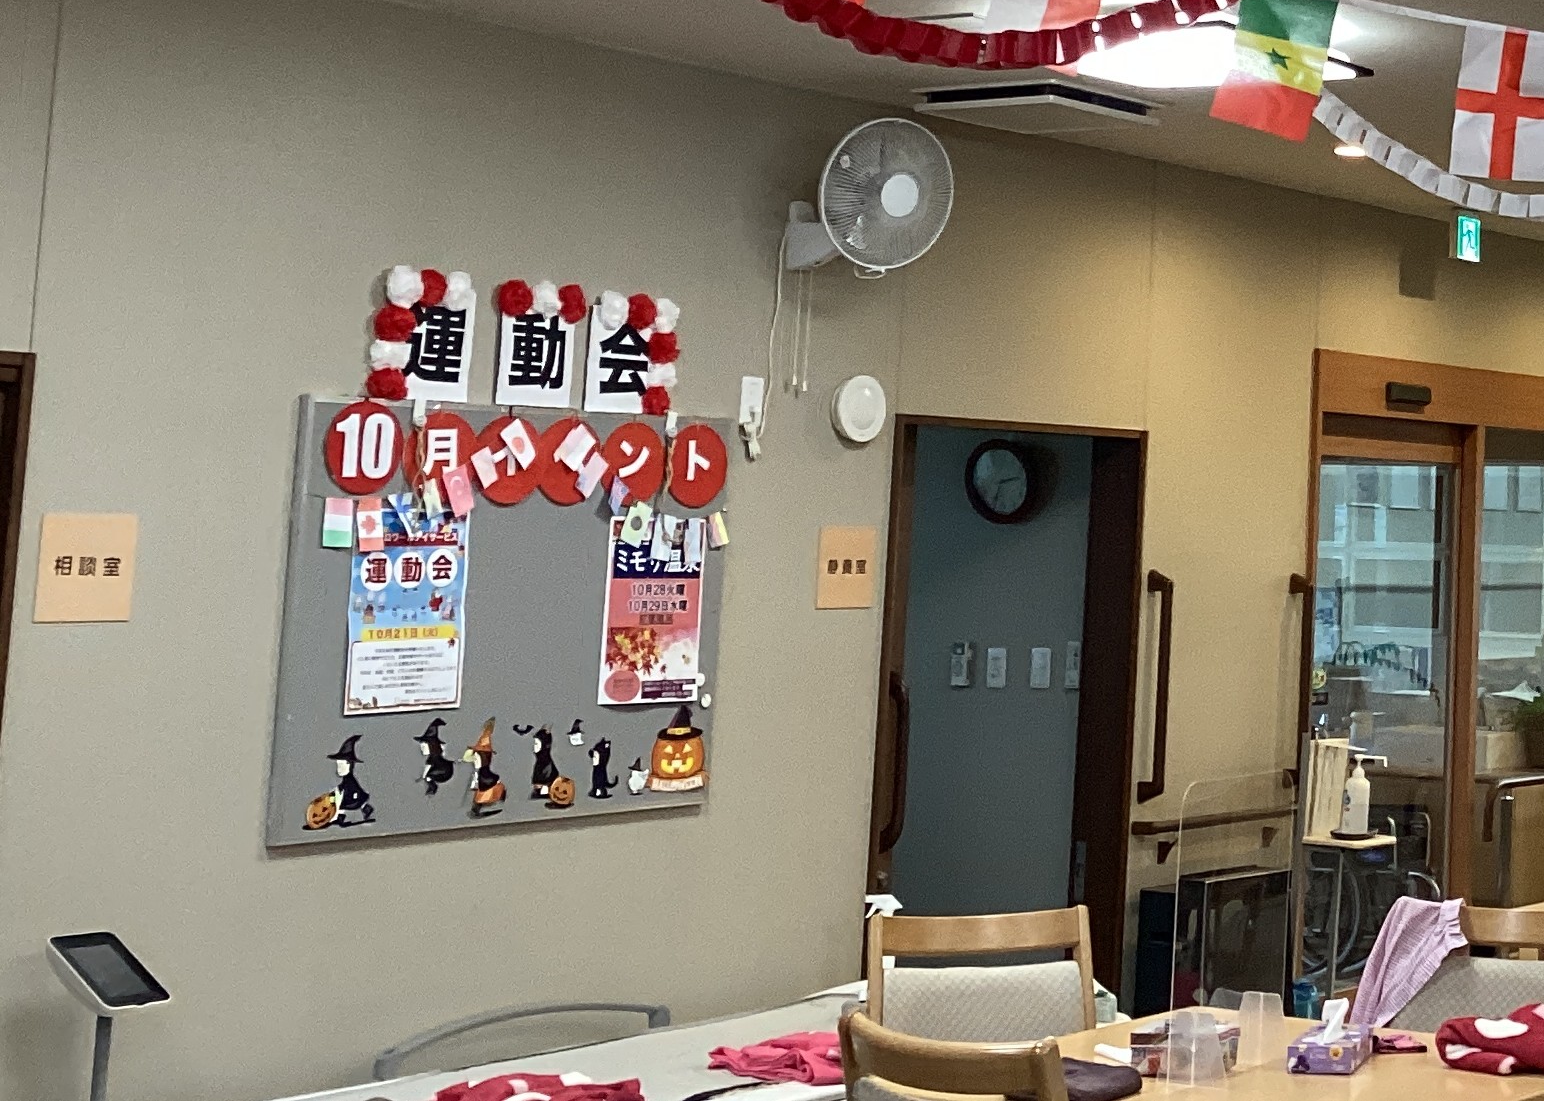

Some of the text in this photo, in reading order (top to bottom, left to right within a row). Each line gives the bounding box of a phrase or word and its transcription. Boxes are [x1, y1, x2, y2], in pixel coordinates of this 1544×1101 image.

[402, 301, 650, 397] 運動会
[54, 555, 121, 577] 相談室
[365, 554, 453, 584] 運動会
